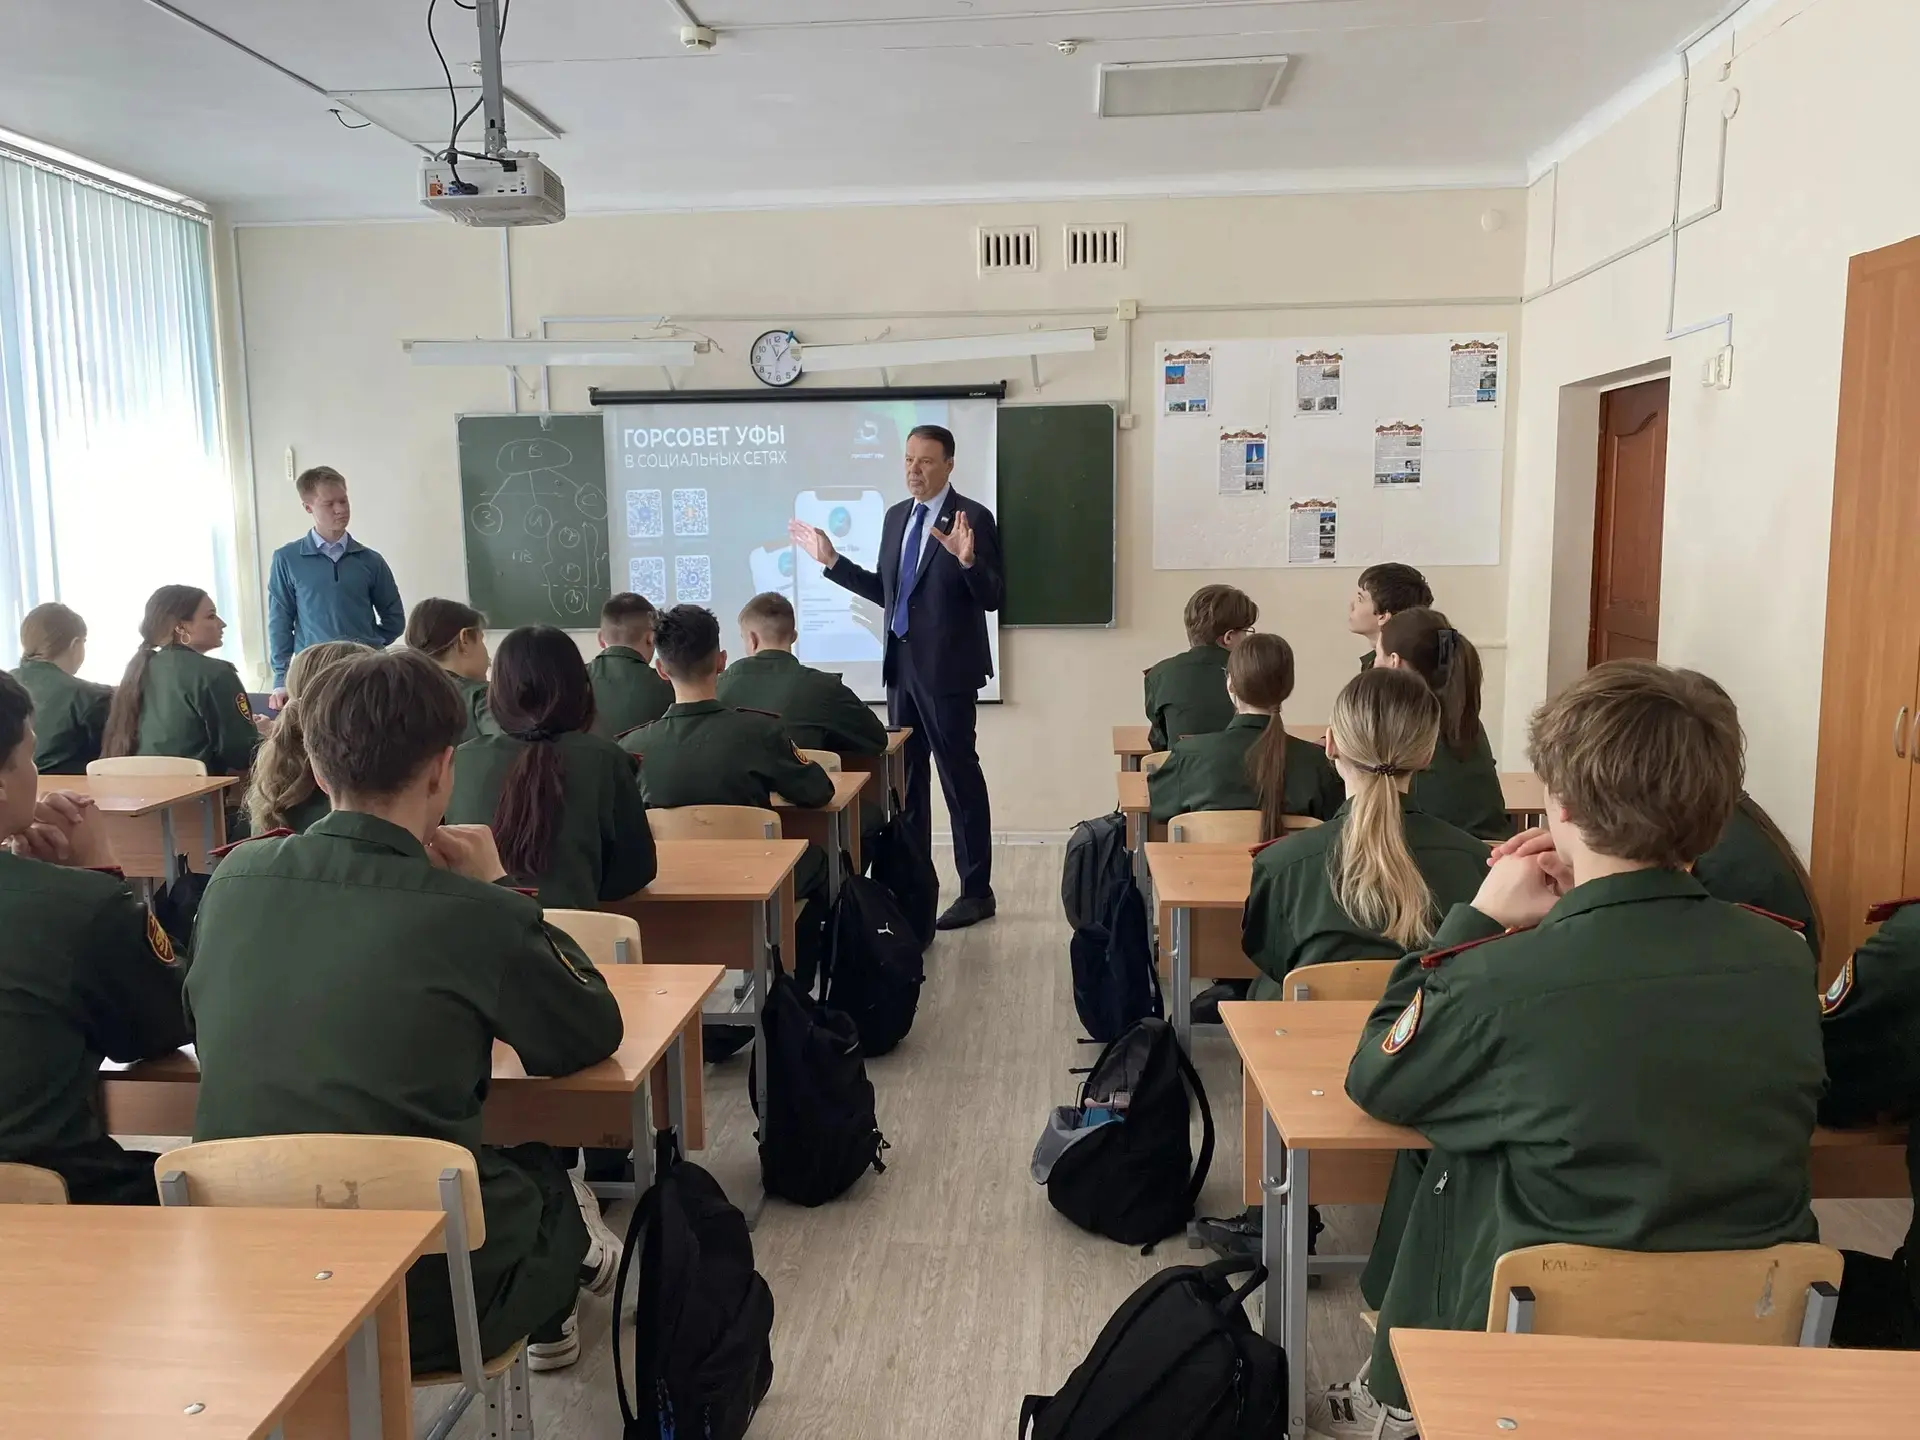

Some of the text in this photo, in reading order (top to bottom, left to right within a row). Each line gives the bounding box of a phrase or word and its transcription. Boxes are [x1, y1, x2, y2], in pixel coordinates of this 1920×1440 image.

[774, 335, 781, 343] 12
[758, 345, 767, 354] 10
[755, 354, 762, 363] 9
[767, 372, 772, 380] 7
[775, 374, 782, 382] 6
[624, 425, 785, 448] ГОРСОВЕТ УФЫ
[625, 451, 787, 470] В СОЦИАЛЬНЫХ СЕТЯХ
[1327, 1396, 1357, 1424] N
